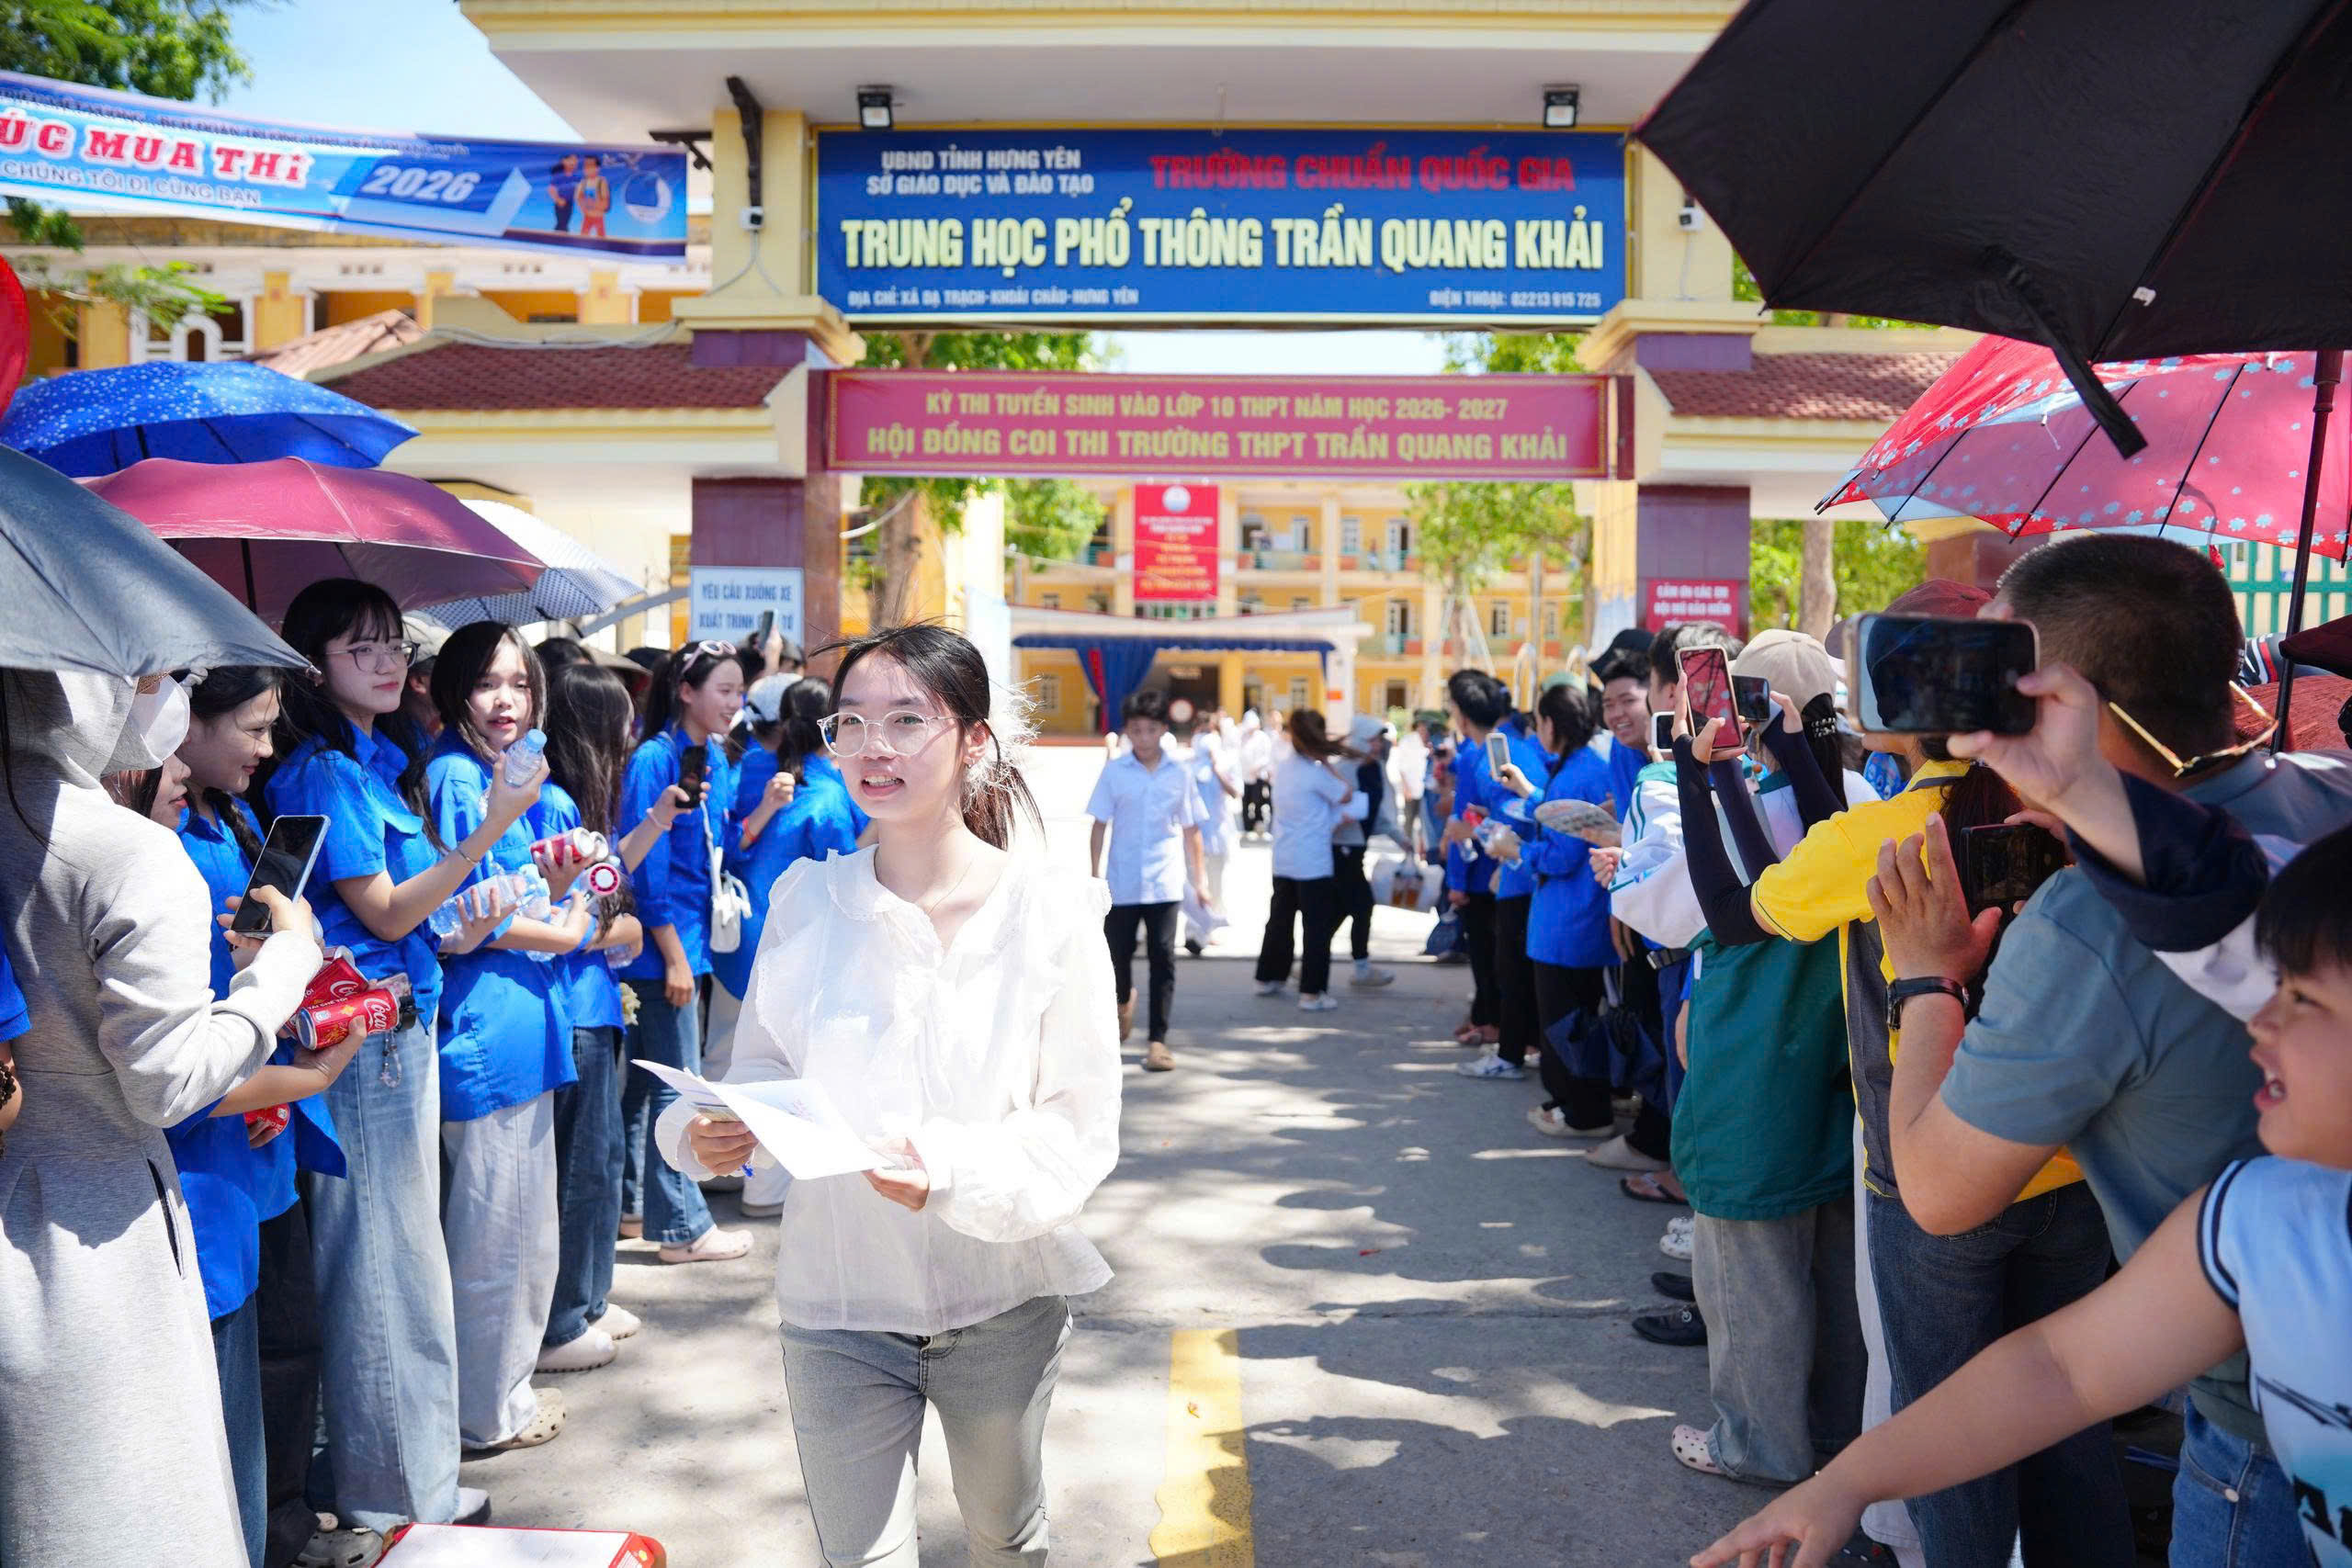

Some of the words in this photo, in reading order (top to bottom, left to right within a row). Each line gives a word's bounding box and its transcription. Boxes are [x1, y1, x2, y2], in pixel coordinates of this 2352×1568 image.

[883, 150, 933, 169] UBND
[940, 144, 982, 169] TỈNH
[987, 148, 1040, 169] HƯNG
[1044, 146, 1080, 168] YÊN
[1151, 148, 1286, 188] TRƯỜNG
[1295, 141, 1411, 188] CHUẨN
[1420, 145, 1509, 192] QUỐC
[1519, 157, 1574, 192] GIA
[90, 169, 124, 190] TÔI
[129, 178, 151, 194] ĐI
[360, 164, 482, 203] 2026
[868, 174, 892, 195] SỞ
[897, 174, 940, 194] GIÁO
[944, 174, 981, 196] DỤC
[987, 172, 1011, 194] VÀ
[1015, 172, 1053, 194] ĐÀO
[1059, 174, 1093, 197] TẠO
[841, 217, 964, 267] TRUNG
[972, 217, 1046, 277] HỌC
[1055, 194, 1133, 267] PHỔ
[1138, 207, 1263, 267] THÔNG
[1271, 201, 1373, 266] TRẦN
[1381, 216, 1508, 273] QUANG
[1515, 205, 1603, 269] KHẢI
[1428, 287, 1463, 308] ĐIỆN
[926, 387, 953, 413] KỲ
[958, 391, 990, 414] THI
[995, 385, 1060, 416] TUYỂN
[1065, 391, 1115, 416] SINH
[1119, 390, 1160, 417] VÀO
[1164, 390, 1204, 418] LỚP
[1210, 396, 1236, 418] 10
[1239, 396, 1290, 418] THPT
[1294, 392, 1343, 419] NĂM
[1348, 396, 1390, 423] HỌC
[1457, 398, 1509, 421] 2027
[867, 422, 915, 459] HỘI
[922, 419, 1001, 456] ĐỒNG
[1009, 428, 1057, 457] COI
[1064, 428, 1109, 457] THI
[1116, 424, 1230, 458] TRƯỜNG
[1237, 431, 1307, 458] THPT
[1313, 423, 1390, 460] TRẦN
[1396, 433, 1493, 462] QUANG
[1499, 425, 1567, 460] KHẢI
[702, 581, 718, 600] YÊU
[781, 585, 791, 601] XE
